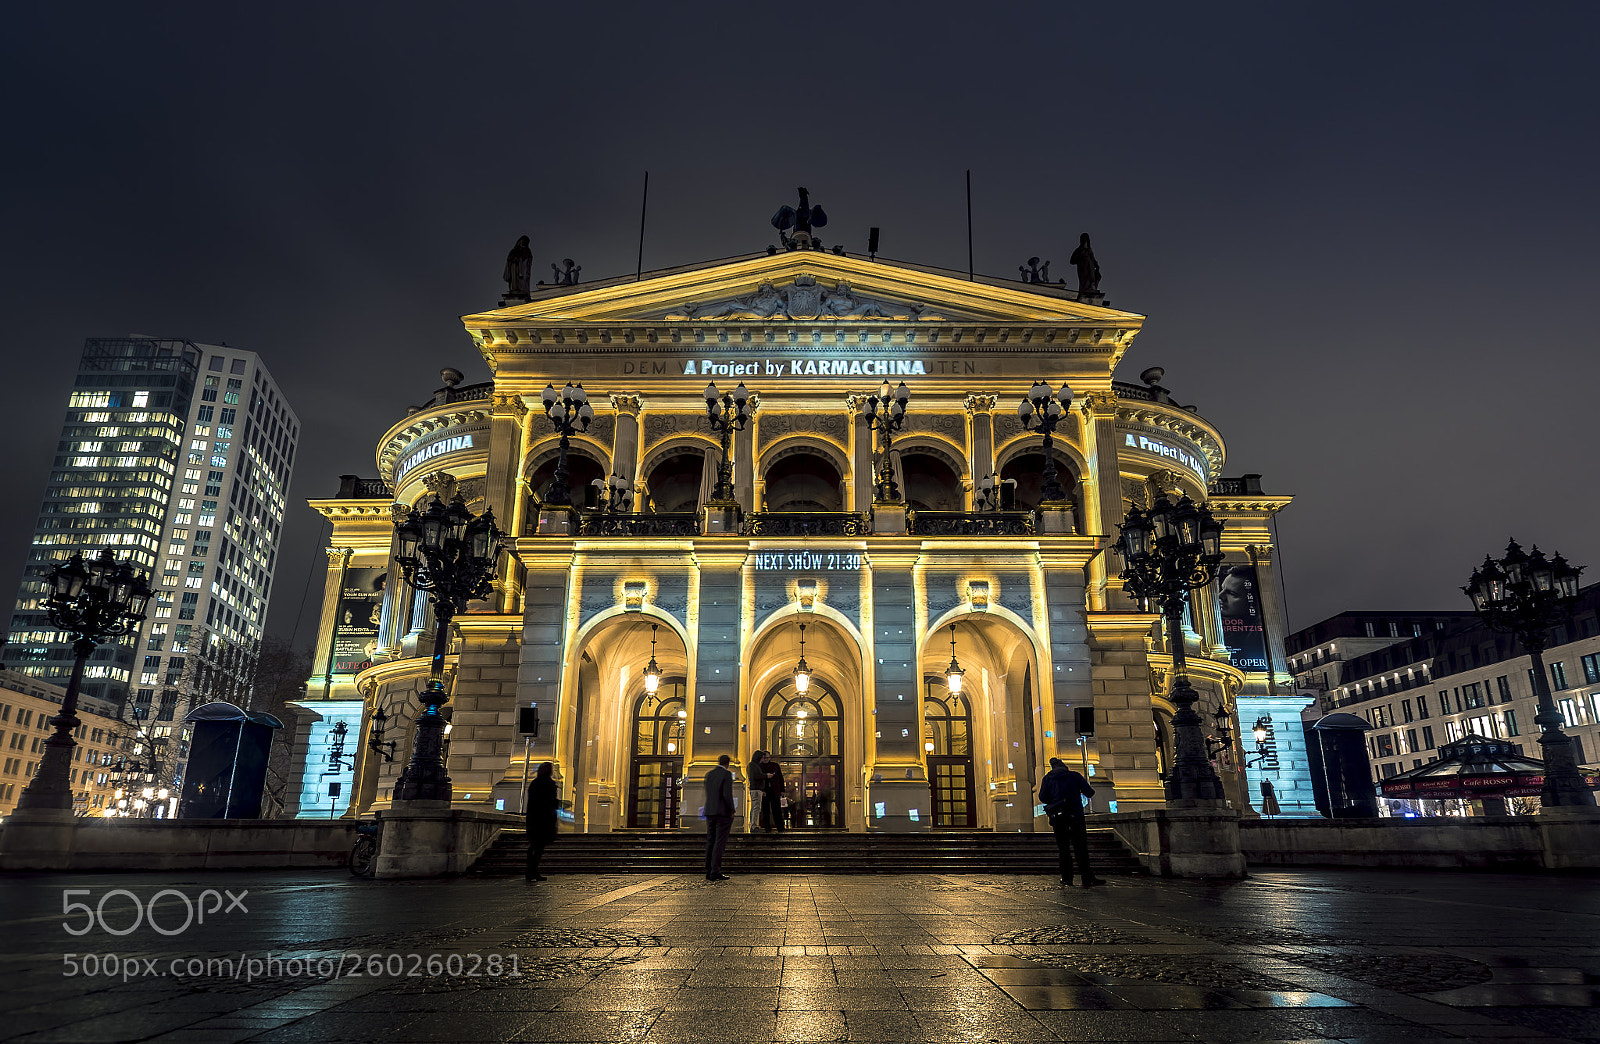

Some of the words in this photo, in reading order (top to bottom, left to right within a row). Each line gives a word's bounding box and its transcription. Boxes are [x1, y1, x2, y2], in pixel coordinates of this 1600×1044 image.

[624, 361, 667, 375] DEM
[683, 359, 697, 375] A
[700, 359, 760, 377] Project
[765, 359, 785, 377] by
[790, 360, 927, 375] KARMACHINA
[402, 434, 474, 476] KARMACHINA
[1125, 433, 1138, 448] A
[1139, 435, 1178, 459] Project
[1179, 448, 1189, 466] by
[755, 554, 785, 570] NEXT
[787, 552, 823, 570] SHOW
[827, 554, 861, 570] 21:30
[334, 661, 360, 670] ALTE
[1239, 658, 1267, 667] OPER
[1483, 777, 1513, 786] ROSSO
